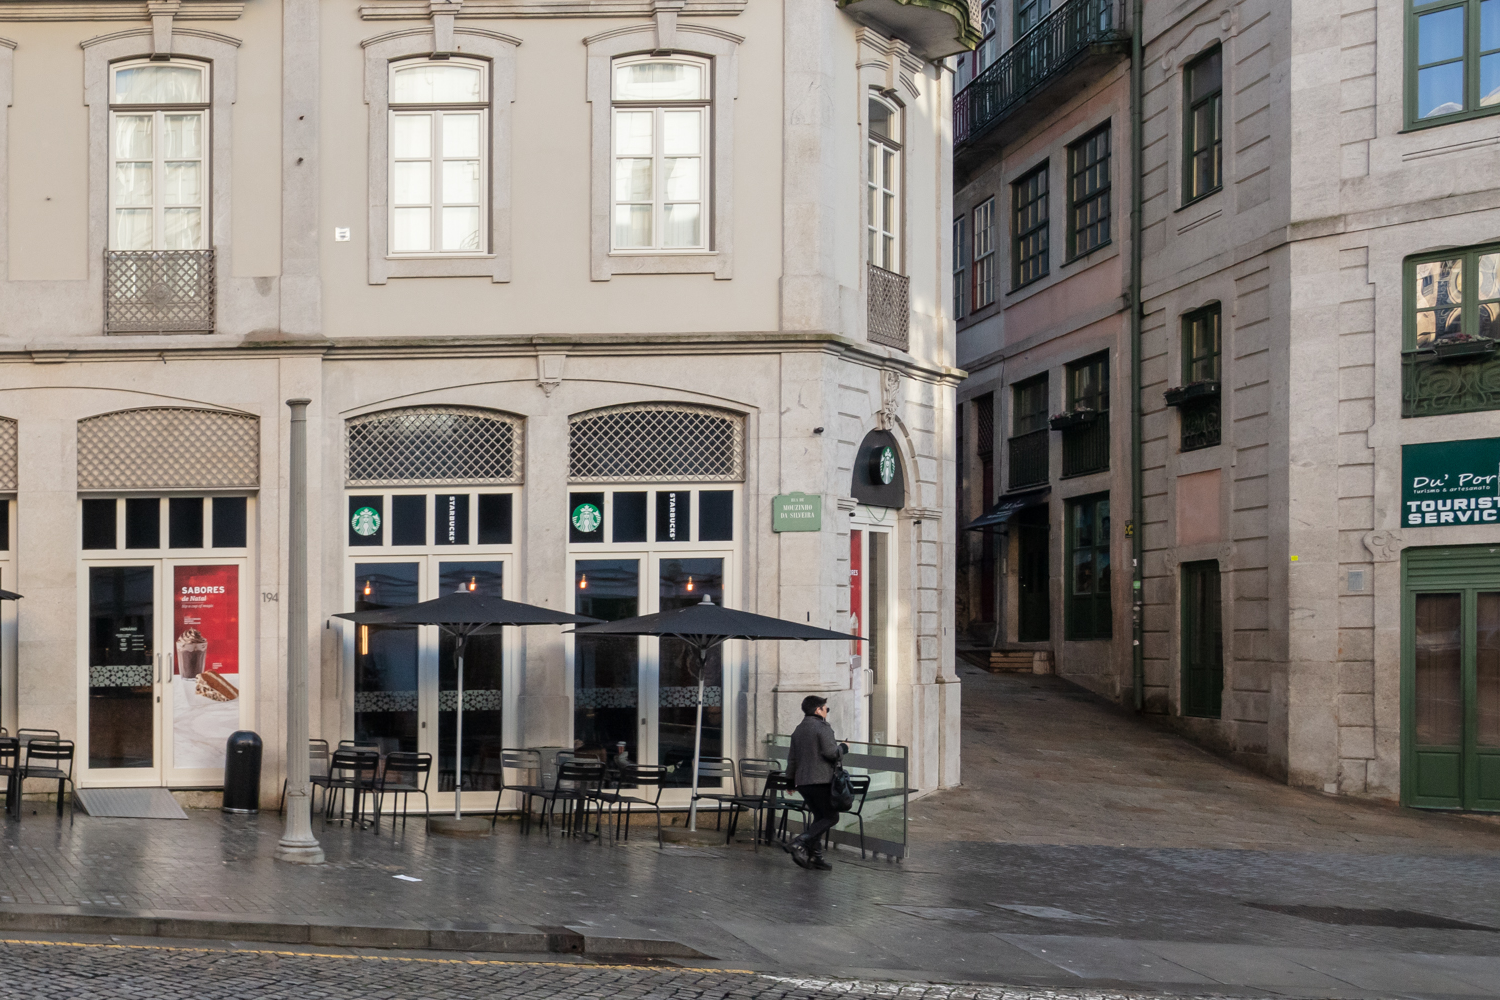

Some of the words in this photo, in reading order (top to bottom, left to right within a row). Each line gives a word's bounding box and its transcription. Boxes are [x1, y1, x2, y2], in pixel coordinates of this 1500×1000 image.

[1407, 497, 1500, 512] TOURIST
[1408, 509, 1498, 525] SERVIC
[181, 586, 225, 594] SABORES
[261, 592, 279, 603] 194
